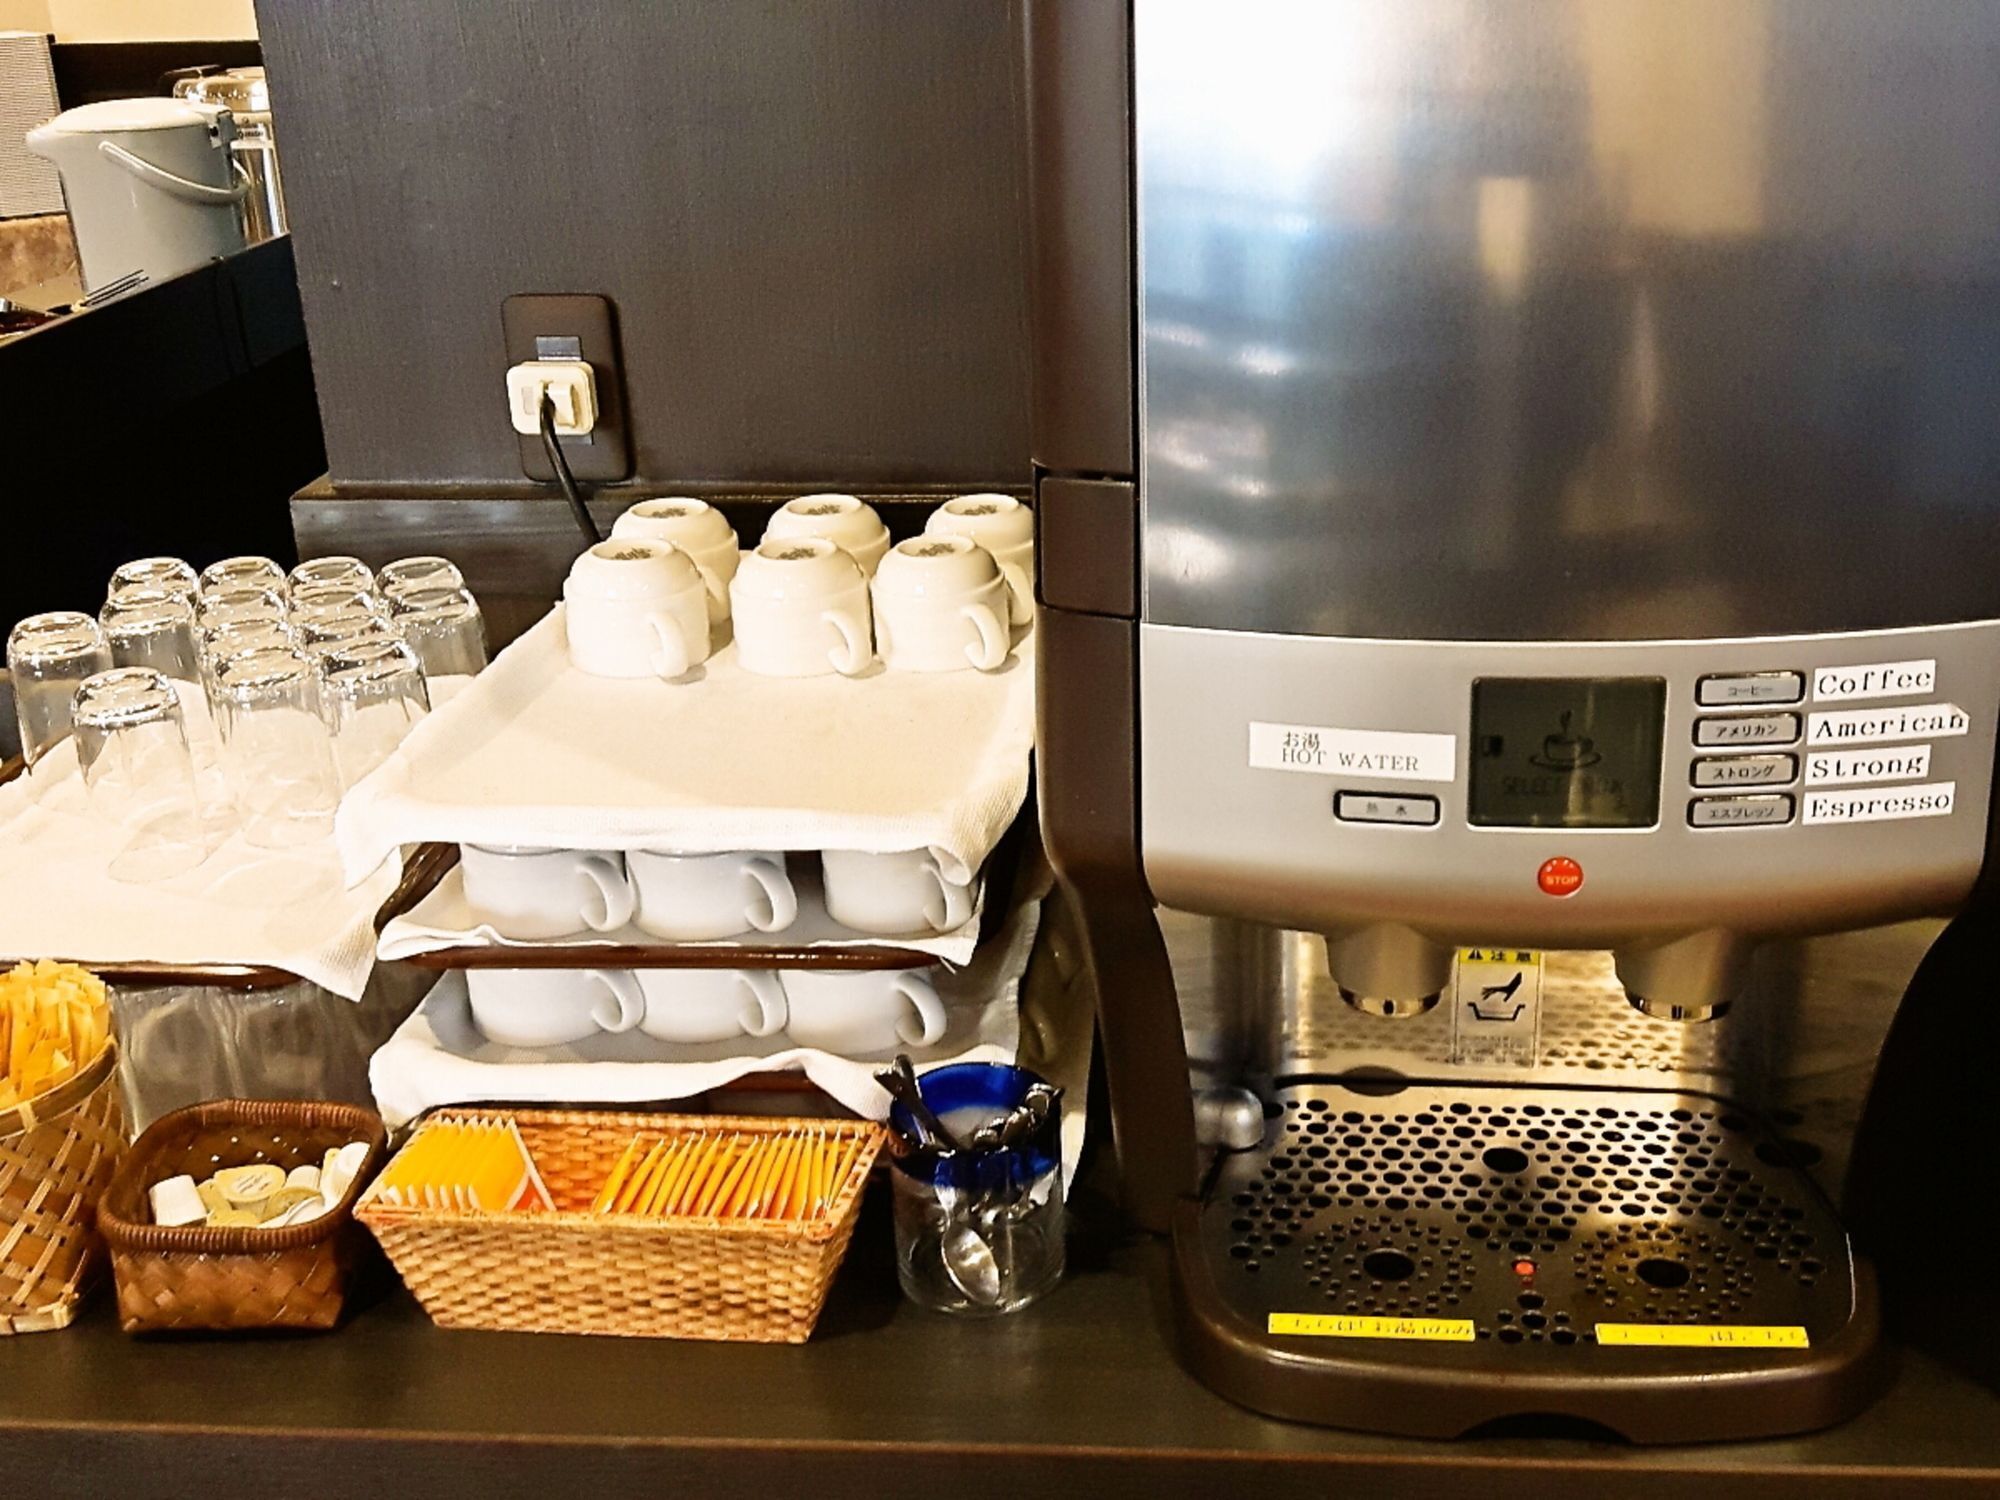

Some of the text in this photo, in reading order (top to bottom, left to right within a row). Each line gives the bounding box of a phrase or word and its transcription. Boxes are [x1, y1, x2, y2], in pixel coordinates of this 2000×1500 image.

[1727, 684, 1774, 697] コーヒー
[1818, 669, 1931, 695] Coffee
[1716, 724, 1778, 738] アメリカン
[1816, 713, 1965, 739] American
[1282, 731, 1320, 752] お湯
[1282, 747, 1419, 771] HOT WATER
[1812, 755, 1924, 779] Strong
[1712, 764, 1777, 779] ストロング
[1810, 792, 1950, 818] Espresso
[1546, 875, 1578, 885] STOP
